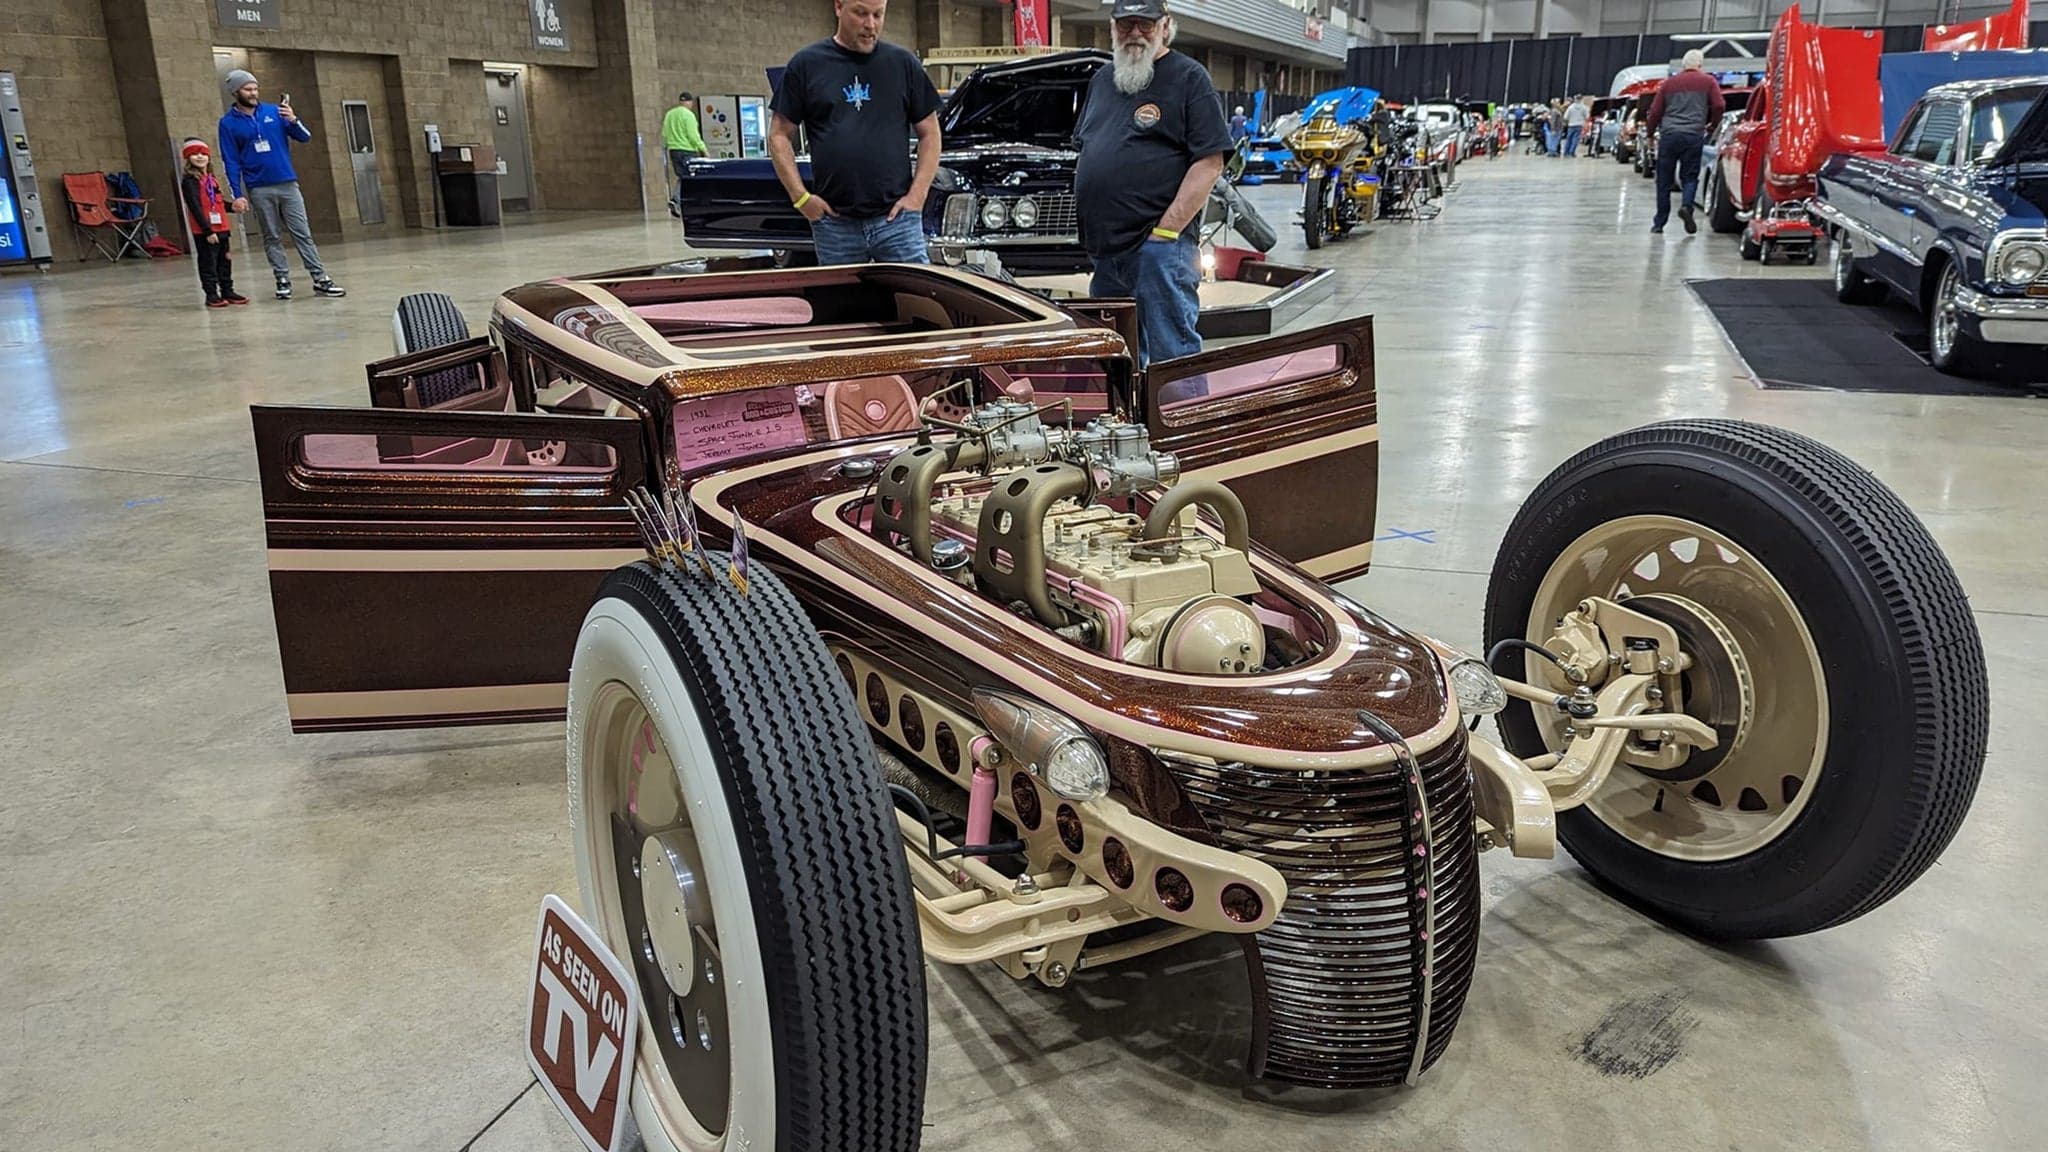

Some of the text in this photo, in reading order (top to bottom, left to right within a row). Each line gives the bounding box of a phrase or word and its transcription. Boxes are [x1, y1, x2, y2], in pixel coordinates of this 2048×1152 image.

[236, 9, 261, 22] MEN
[537, 36, 564, 47] WOMEN
[692, 419, 739, 435] CHEVROLET
[543, 924, 625, 1039] AS SEEN ON
[539, 961, 618, 1114] TV
